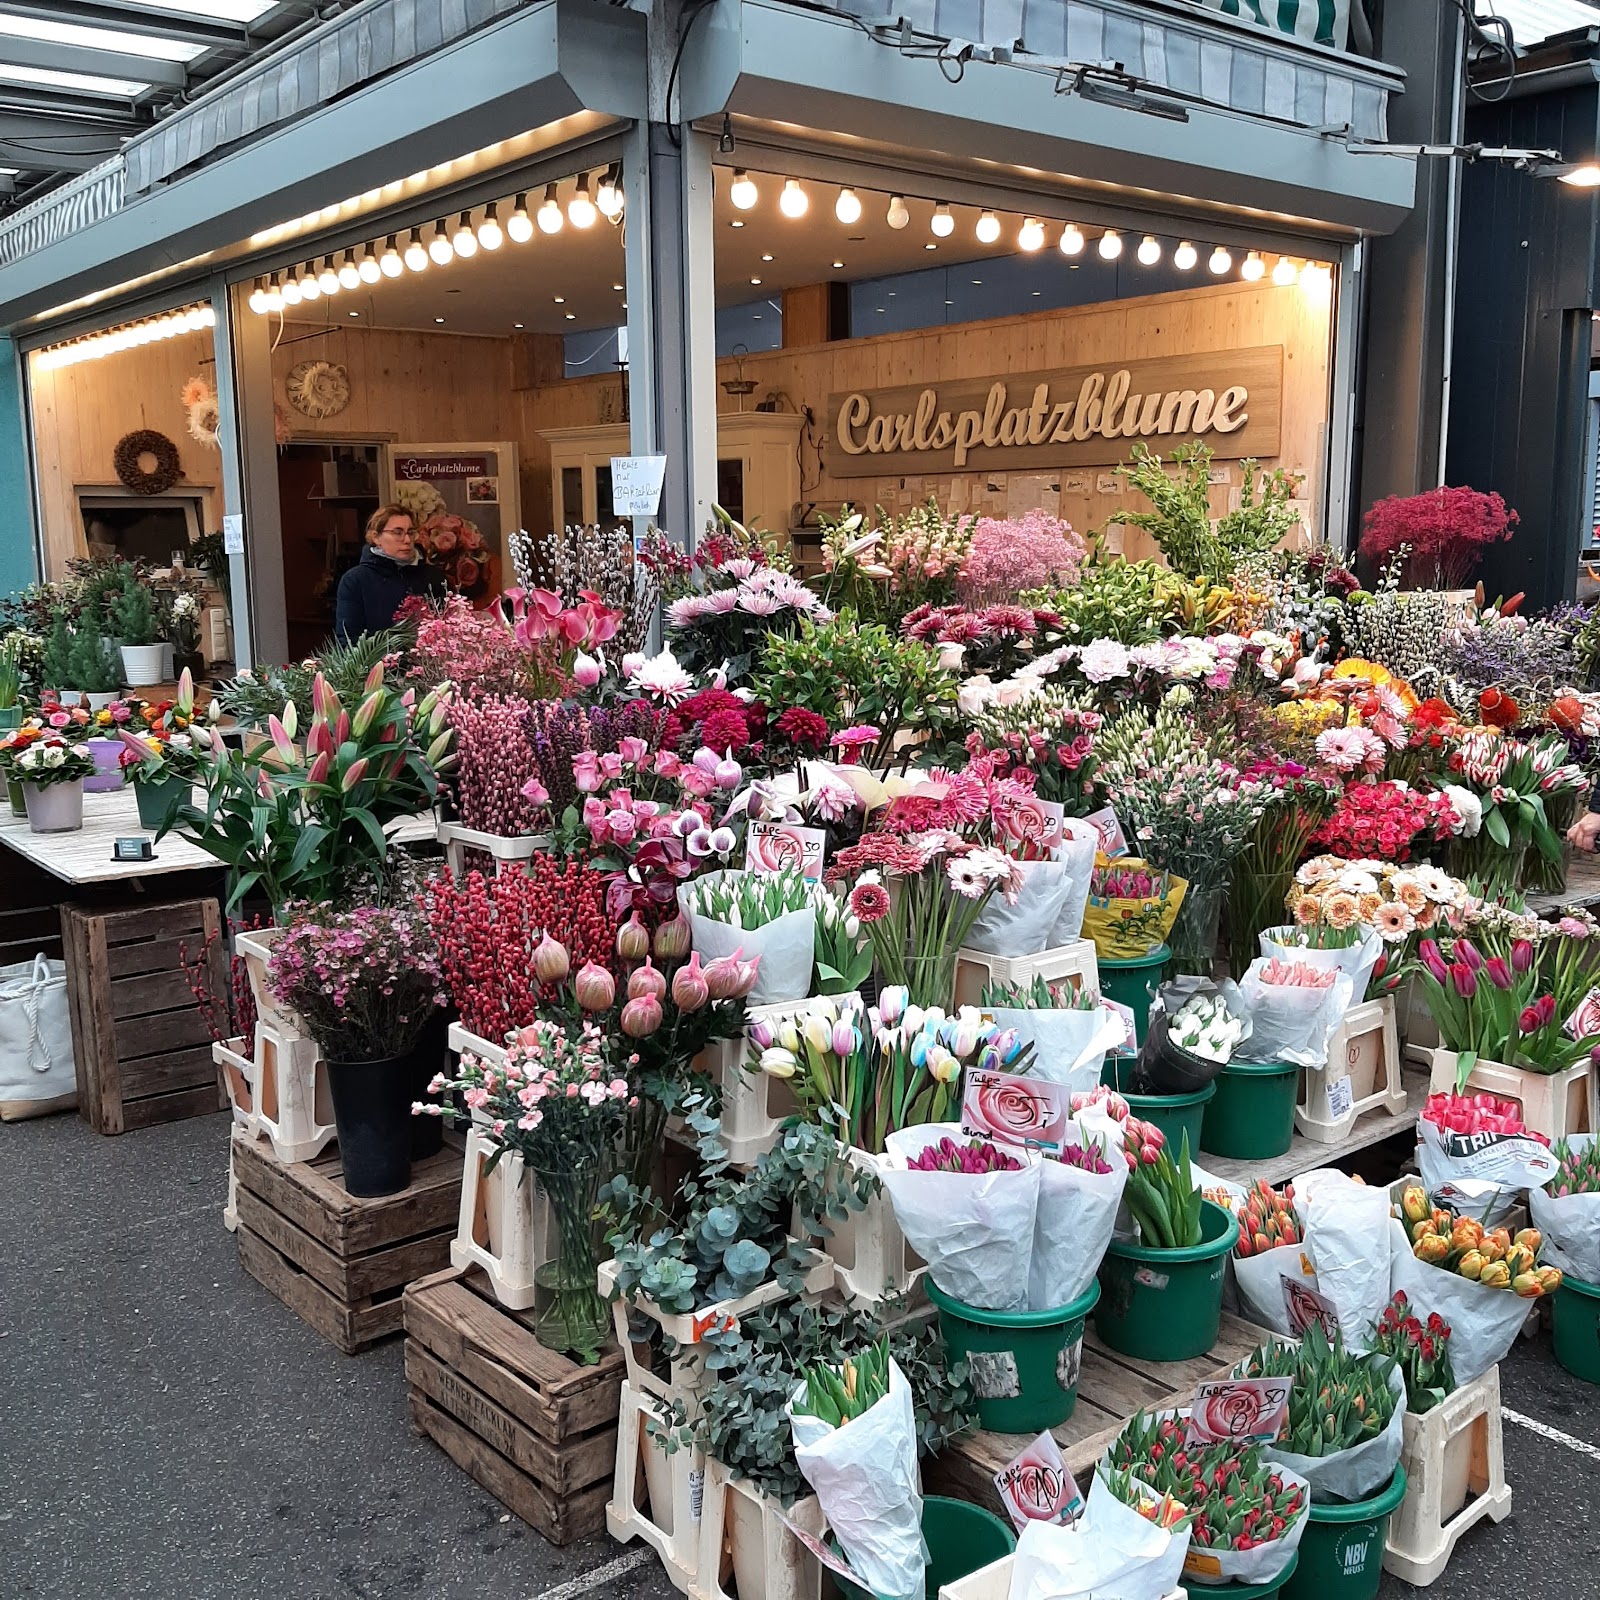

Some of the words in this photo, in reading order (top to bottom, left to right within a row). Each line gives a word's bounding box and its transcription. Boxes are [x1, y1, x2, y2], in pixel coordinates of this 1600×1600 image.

[837, 369, 1248, 466] Carlsplatzblume
[409, 462, 481, 476] Carlsplatzblume
[752, 822, 781, 837] Tulpe
[969, 1071, 1002, 1088] Tulpe
[996, 1464, 1023, 1488] Tulpe
[1344, 1540, 1369, 1567] NBV
[1343, 1563, 1365, 1576] NEUSS
